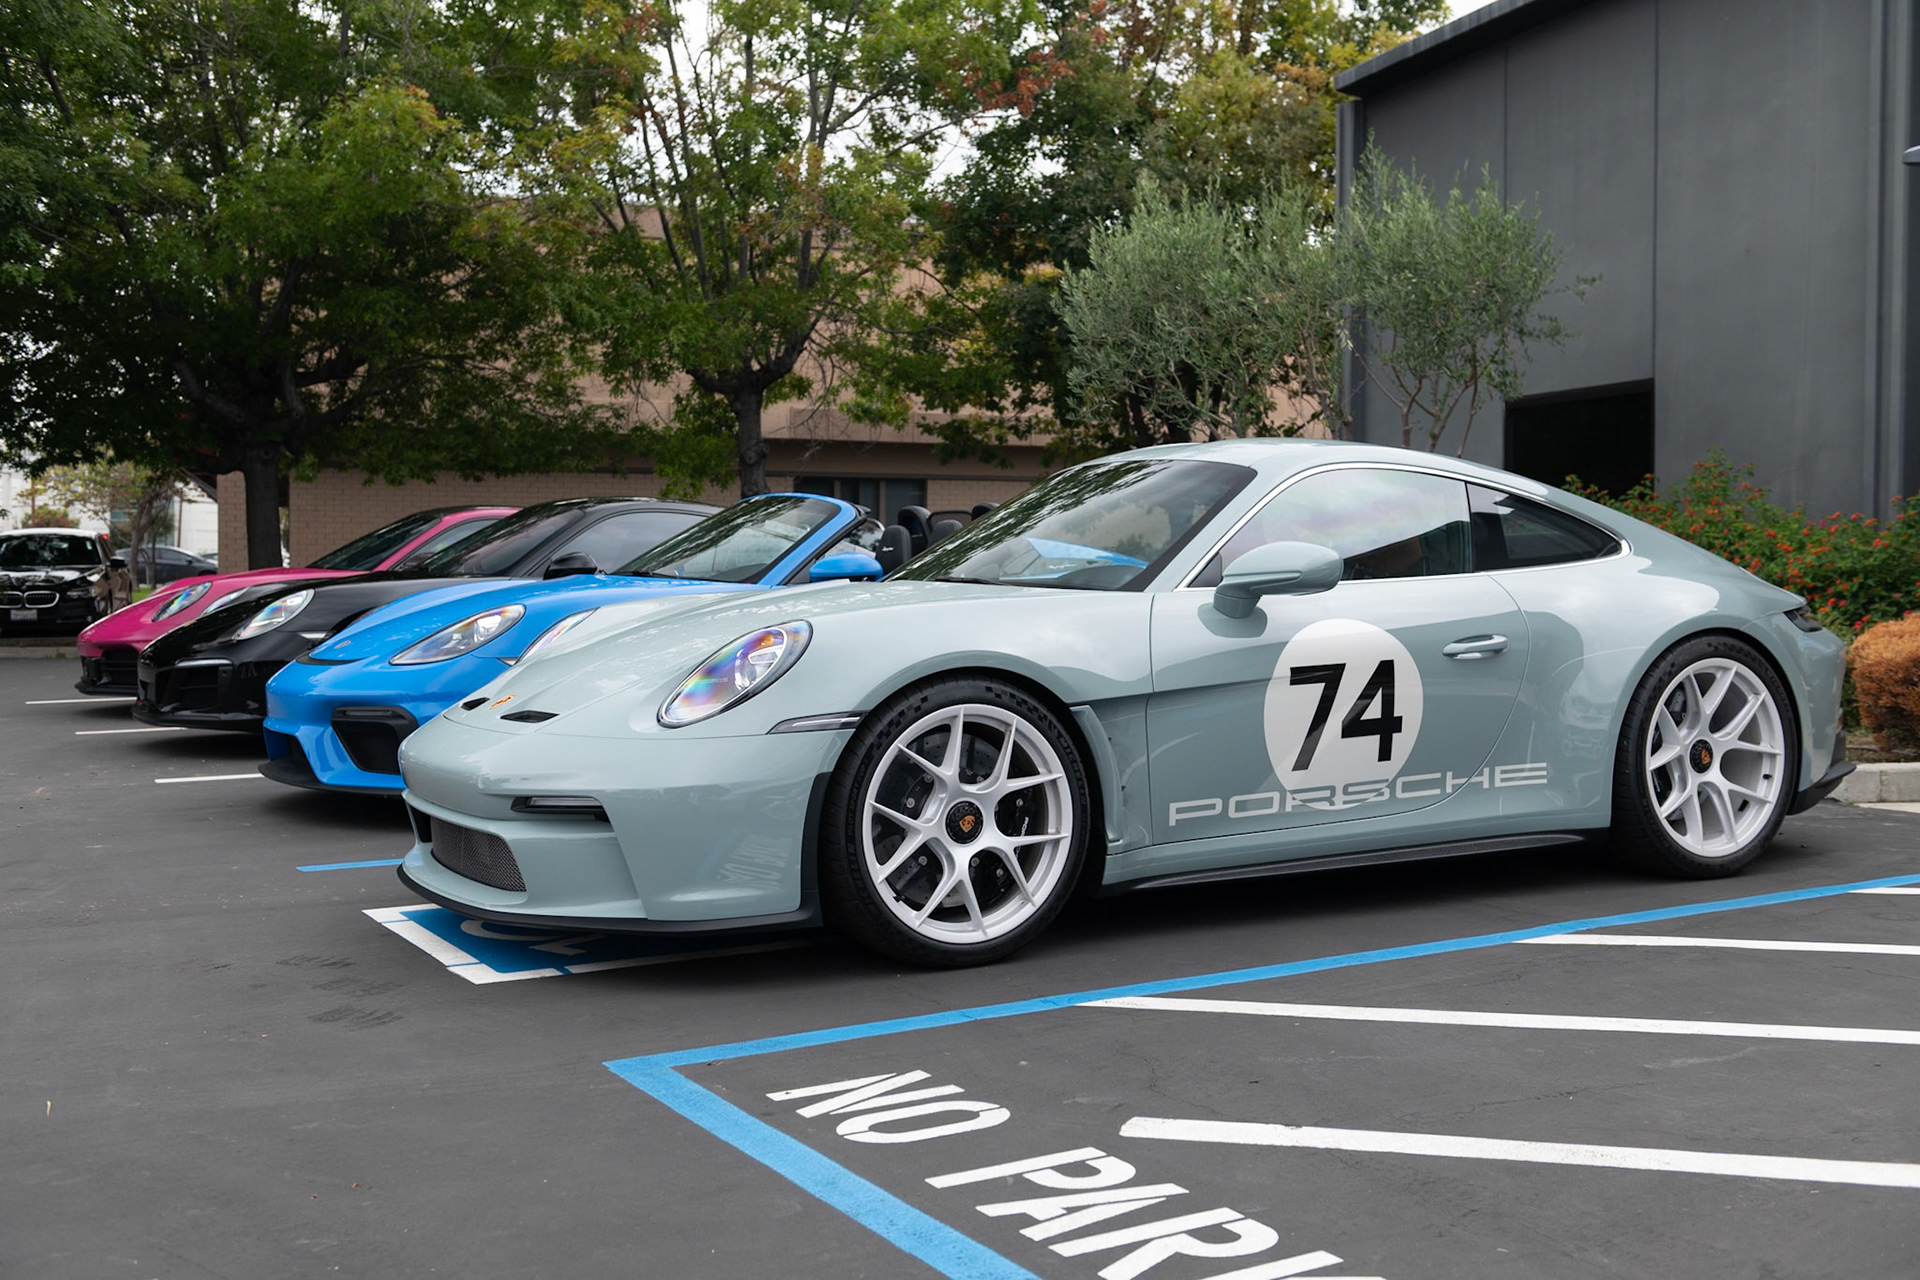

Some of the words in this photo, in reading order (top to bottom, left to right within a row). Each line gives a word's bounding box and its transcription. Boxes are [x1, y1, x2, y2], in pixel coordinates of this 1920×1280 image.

[1289, 659, 1402, 772] 74
[1168, 762, 1548, 827] PORSCHE
[766, 1070, 1010, 1144] NO
